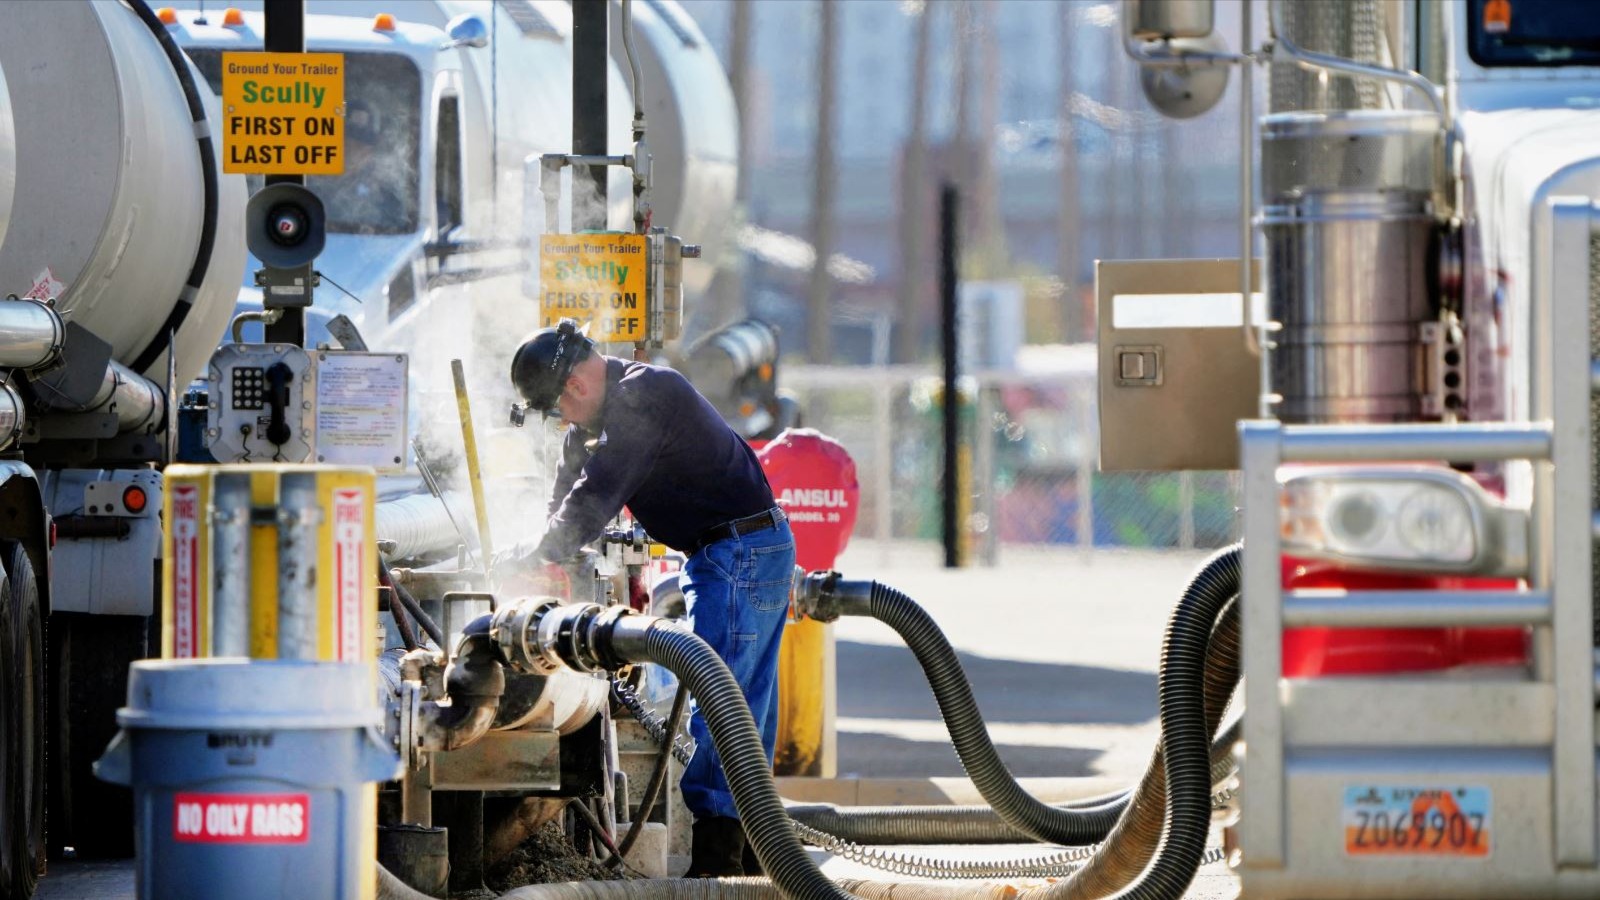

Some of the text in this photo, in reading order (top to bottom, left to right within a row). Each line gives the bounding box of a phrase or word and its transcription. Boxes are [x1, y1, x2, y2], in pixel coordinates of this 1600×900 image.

[228, 63, 339, 75] Ground Your Trailer
[242, 80, 326, 109] Scully
[231, 116, 335, 136] FIRST ON
[231, 145, 337, 165] LAST OFF
[544, 243, 642, 255] Ground Your Trailer
[545, 292, 637, 309] FIRST ON
[601, 317, 639, 335] OFF
[780, 488, 848, 508] ANSUL
[788, 511, 825, 523] MODEL
[177, 802, 304, 838] NO OILY RAGS
